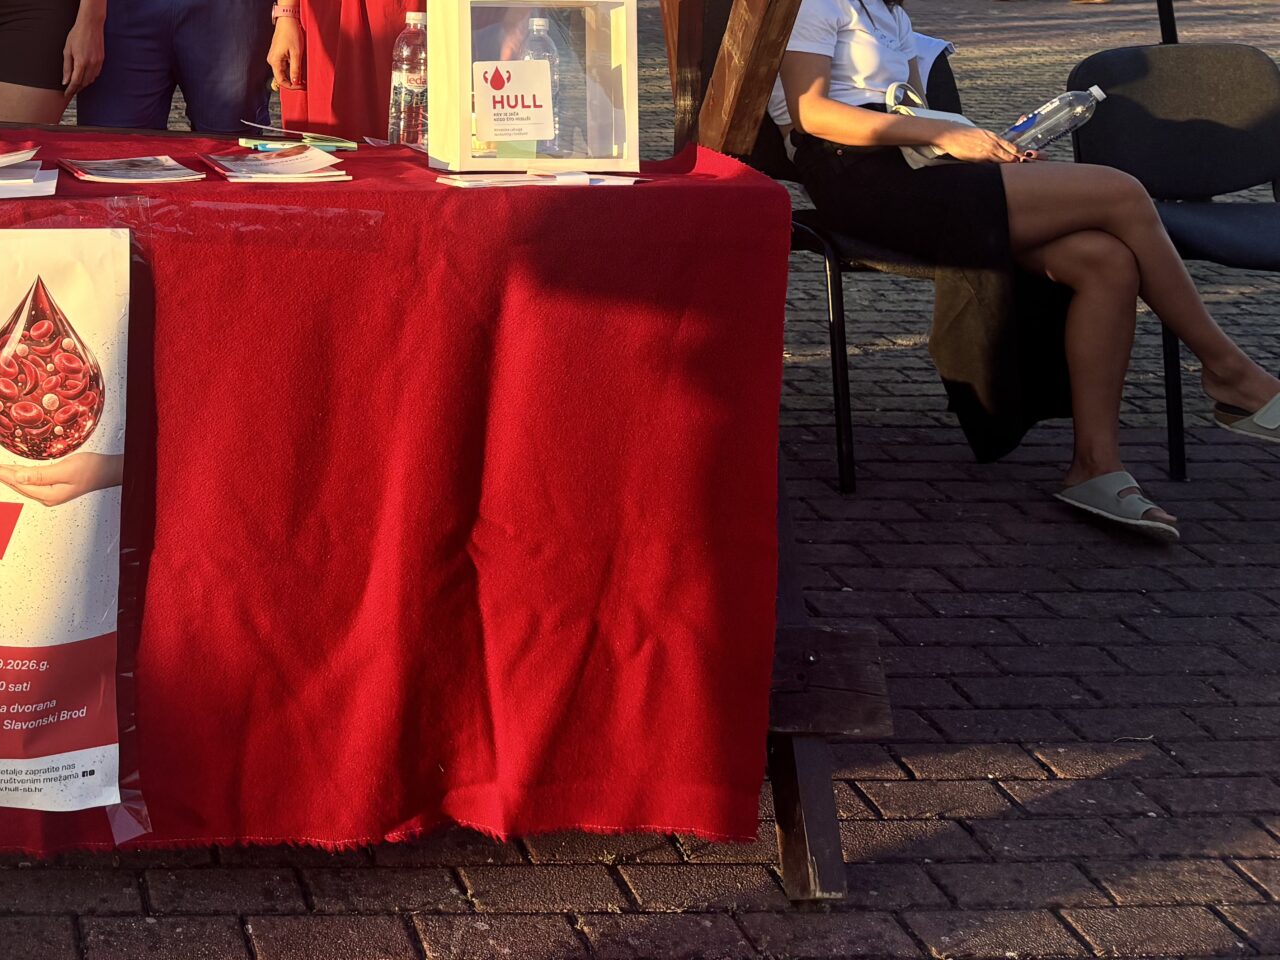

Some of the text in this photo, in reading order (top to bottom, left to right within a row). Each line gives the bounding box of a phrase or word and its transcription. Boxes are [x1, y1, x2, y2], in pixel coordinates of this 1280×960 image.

[492, 94, 543, 109] HULL
[8, 681, 31, 692] sati
[10, 699, 57, 713] dvorana
[3, 713, 57, 730] Slavonski
[59, 706, 87, 721] Brod
[24, 765, 60, 777] zapratite
[61, 763, 76, 771] nas
[42, 772, 79, 784] mrežama
